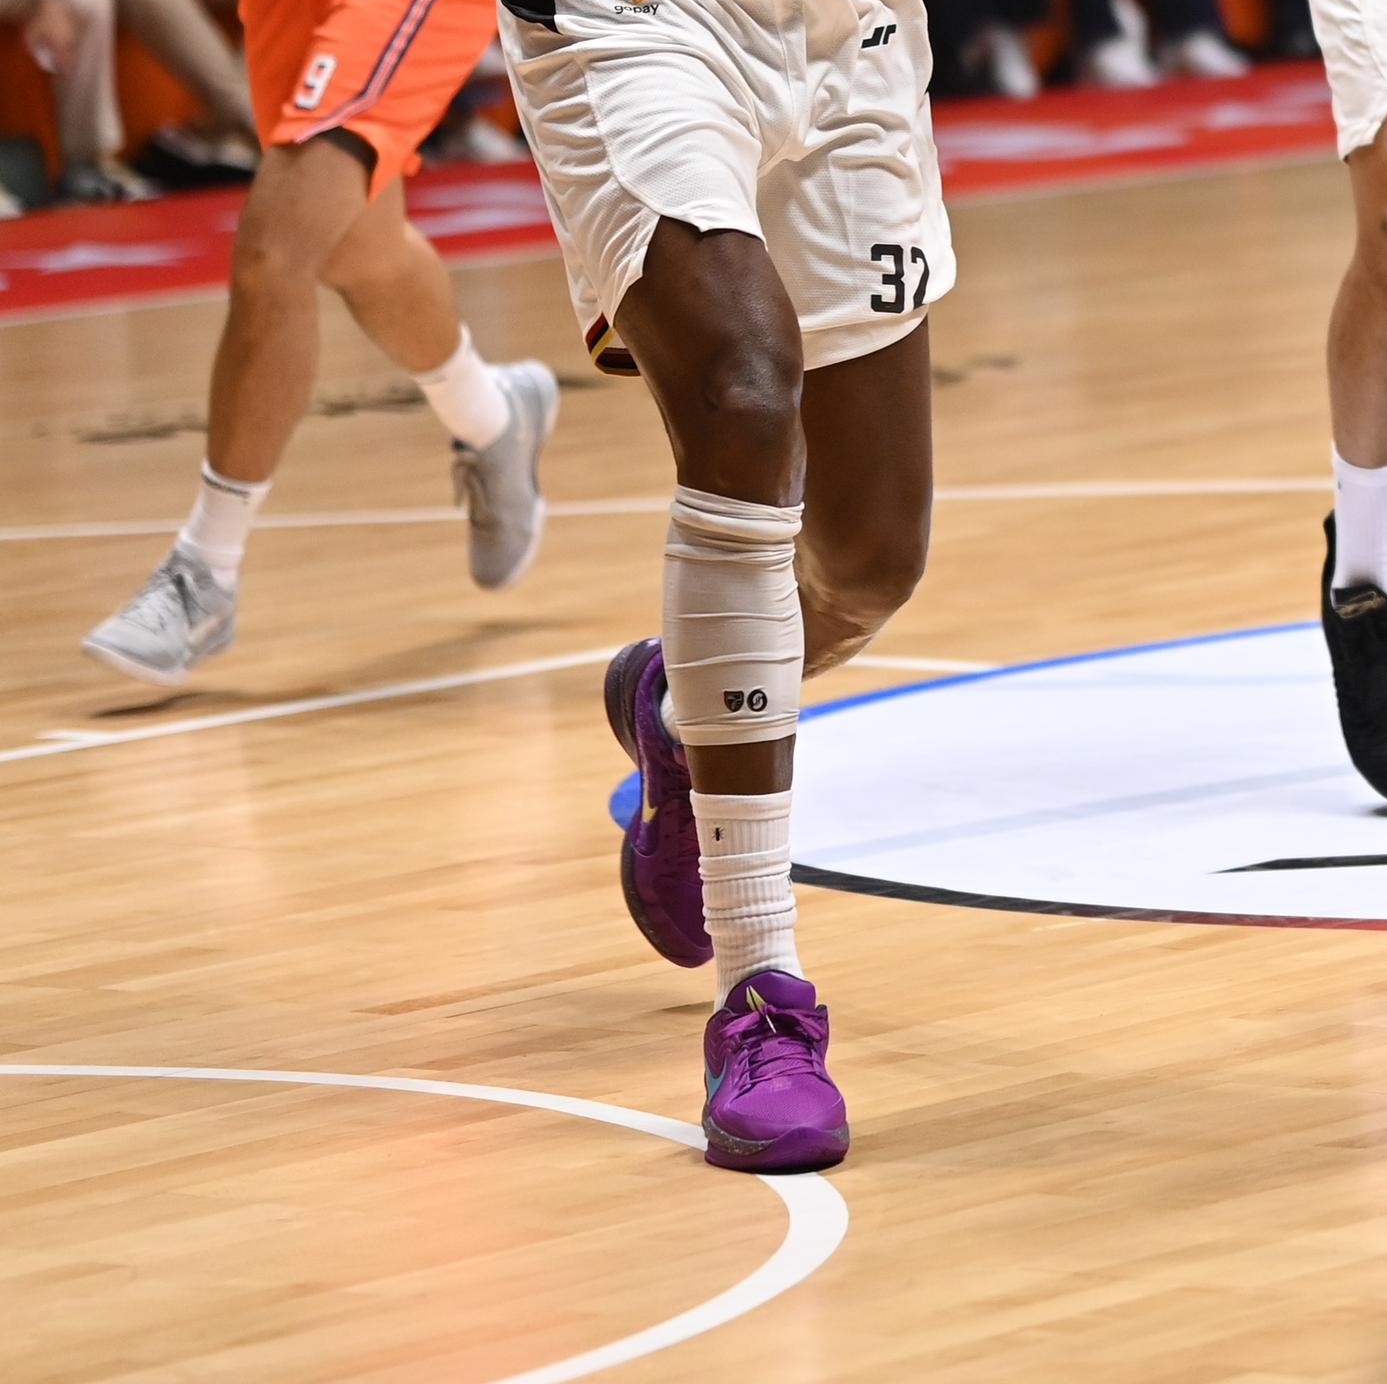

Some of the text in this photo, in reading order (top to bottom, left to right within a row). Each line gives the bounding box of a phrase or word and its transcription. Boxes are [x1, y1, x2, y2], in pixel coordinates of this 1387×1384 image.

[613, 4, 660, 16] gopay
[295, 52, 337, 110] 9
[870, 242, 930, 314] 32
